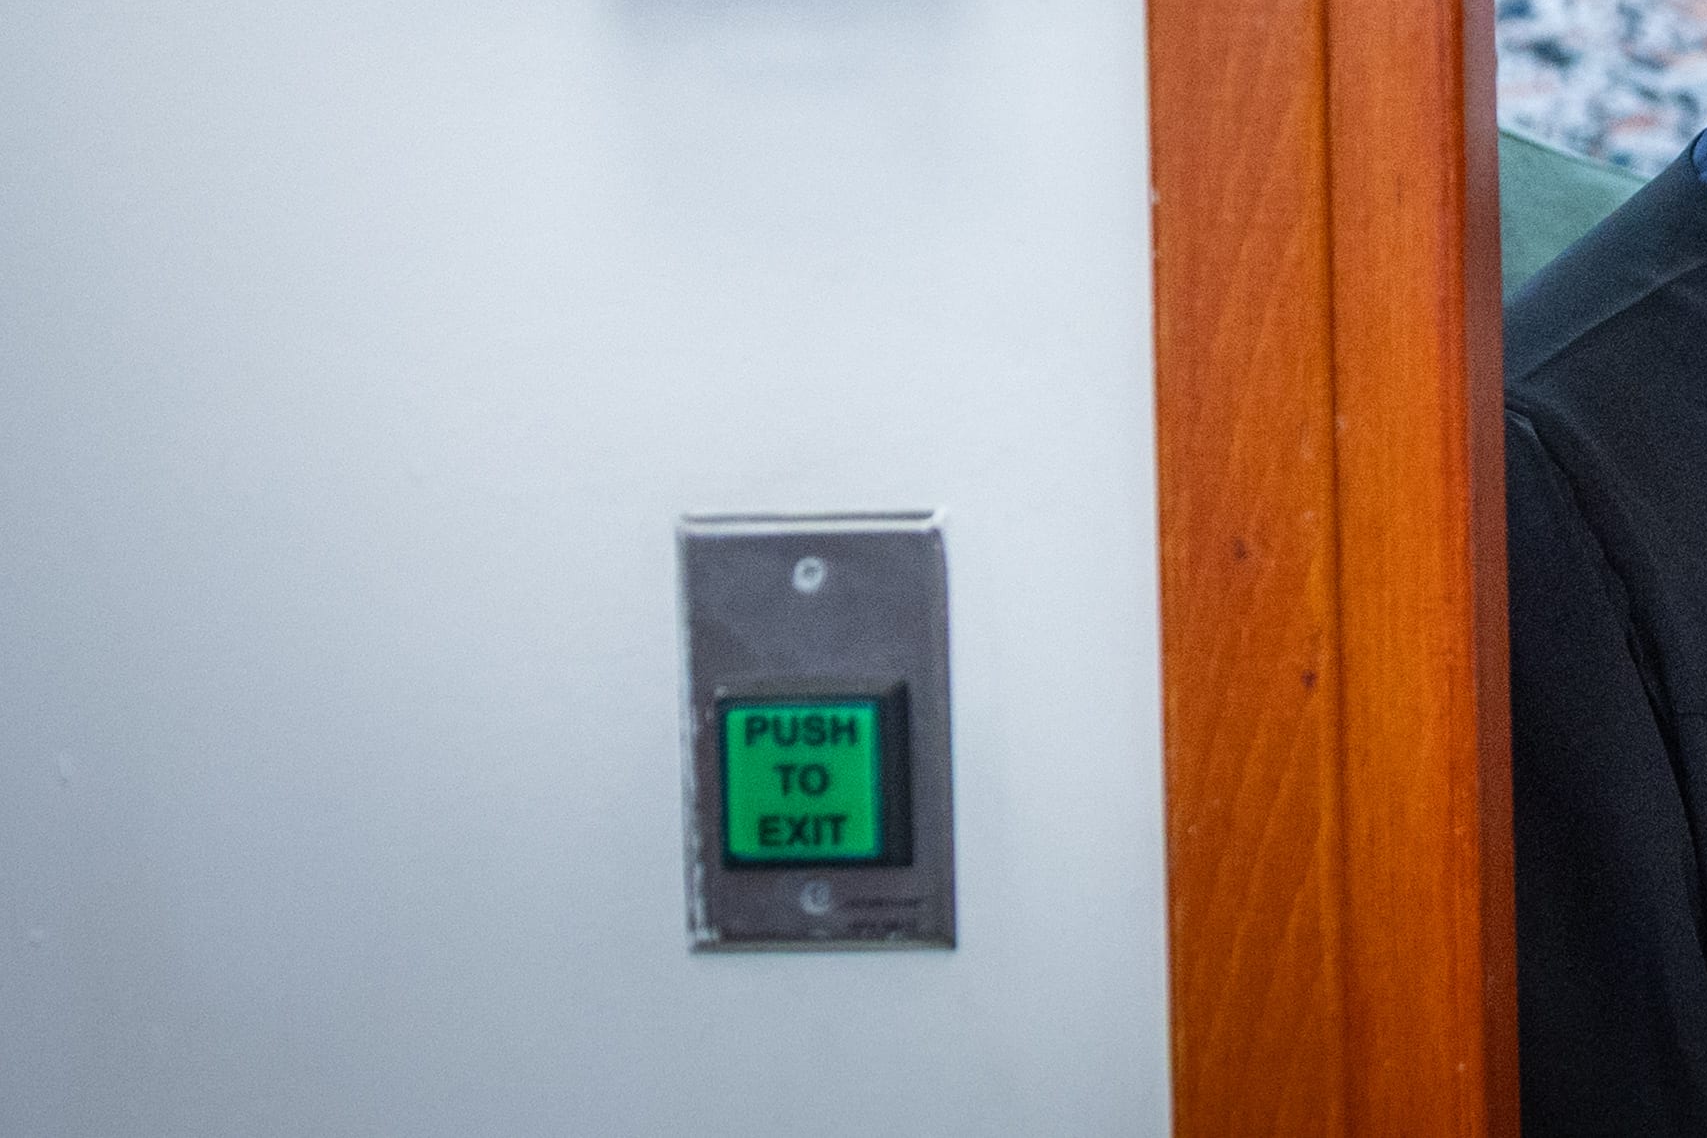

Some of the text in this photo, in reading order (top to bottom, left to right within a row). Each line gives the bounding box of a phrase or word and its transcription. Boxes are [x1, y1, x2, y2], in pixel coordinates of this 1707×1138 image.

[744, 714, 858, 747] PUSH
[774, 764, 831, 797] TO
[757, 815, 848, 847] EXIT
